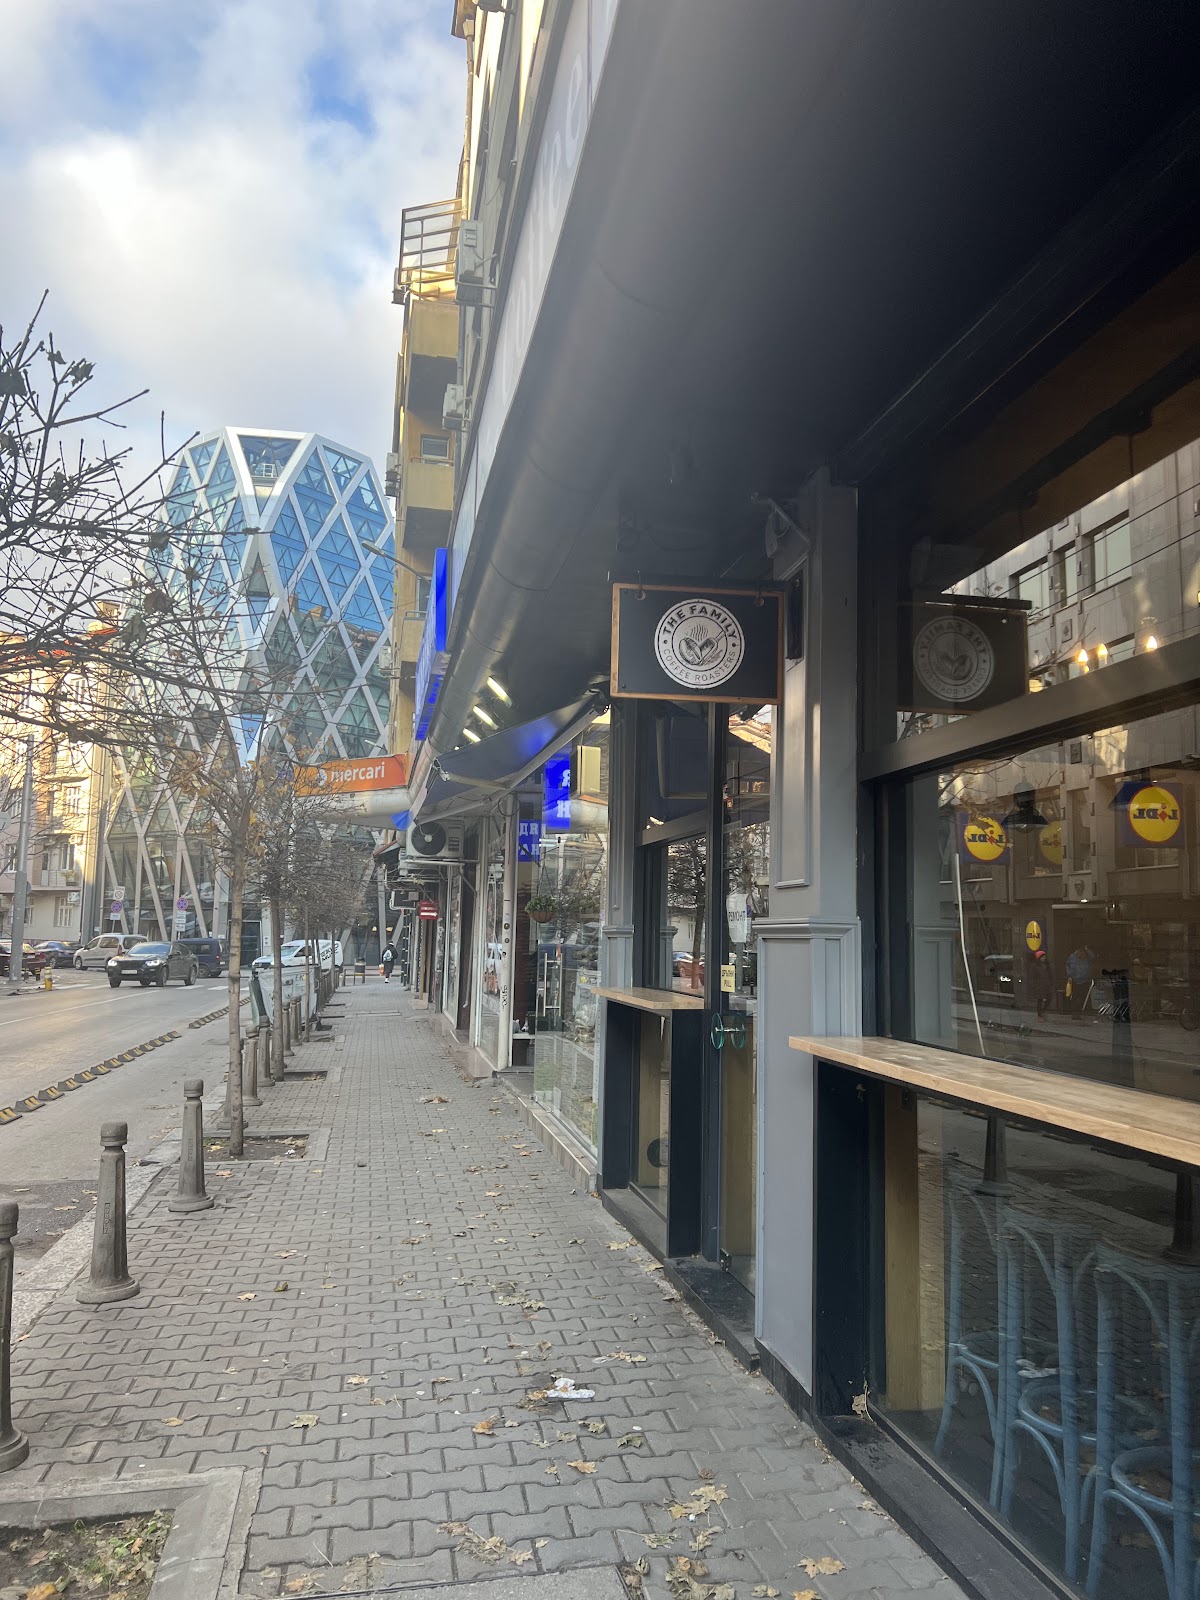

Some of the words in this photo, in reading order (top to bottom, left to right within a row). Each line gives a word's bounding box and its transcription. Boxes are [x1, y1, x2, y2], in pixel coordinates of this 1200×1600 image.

[662, 609, 686, 636] THE
[688, 605, 738, 640] FAMILY
[663, 648, 691, 680] COFFEE
[694, 651, 736, 682] ROASTERS
[331, 761, 386, 783] mercari
